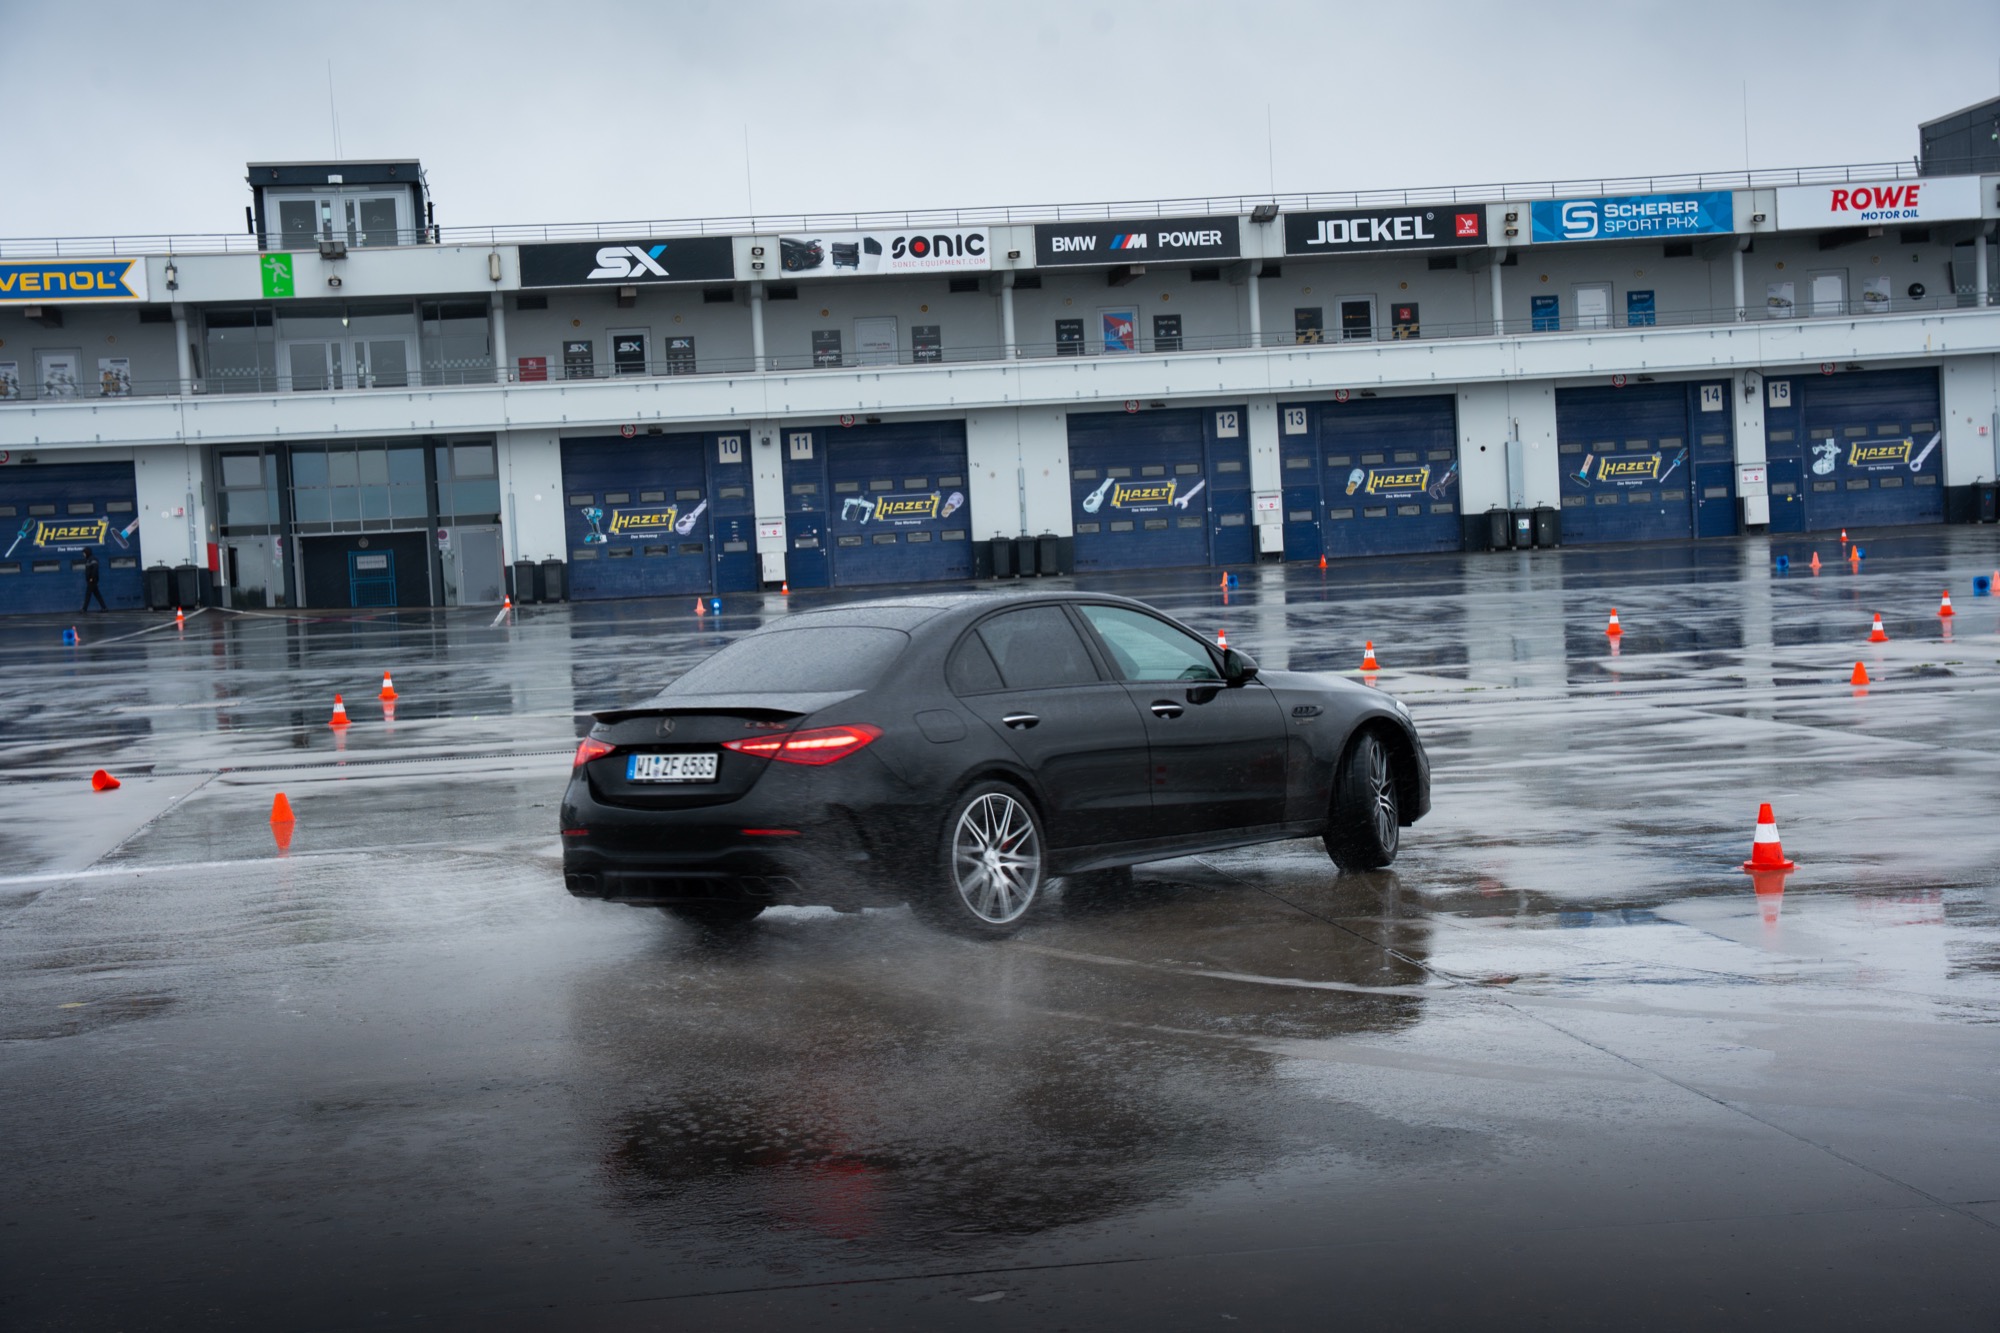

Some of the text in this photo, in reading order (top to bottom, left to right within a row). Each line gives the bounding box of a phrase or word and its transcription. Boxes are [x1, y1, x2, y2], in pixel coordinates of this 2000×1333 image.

[1830, 185, 1920, 211] ROWE
[1604, 200, 1698, 218] SCHERER
[1861, 209, 1920, 220] MOTOR OIL
[1307, 216, 1434, 244] JOCKEL
[1604, 216, 1699, 232] SPORT PHX
[892, 234, 985, 259] SONIC
[1052, 236, 1096, 252] BMW
[1158, 230, 1222, 247] POWER
[586, 245, 670, 279] SX
[892, 258, 986, 268] SONIC-EQUIPMENT.COM
[1704, 388, 1720, 402] 14
[1772, 384, 1788, 398] 15
[1219, 414, 1236, 428] 12
[1288, 411, 1304, 425] 13
[722, 439, 738, 454] 10
[794, 436, 808, 450] 11
[1856, 447, 1905, 460] HAZET
[1605, 462, 1653, 475] HAZET
[1373, 474, 1422, 487] HAZET
[1119, 488, 1168, 501] HAZET
[882, 501, 932, 514] HAZET
[618, 514, 669, 528] HAZET
[43, 526, 99, 540] HAZET
[636, 756, 714, 776] WI ZF 6583
